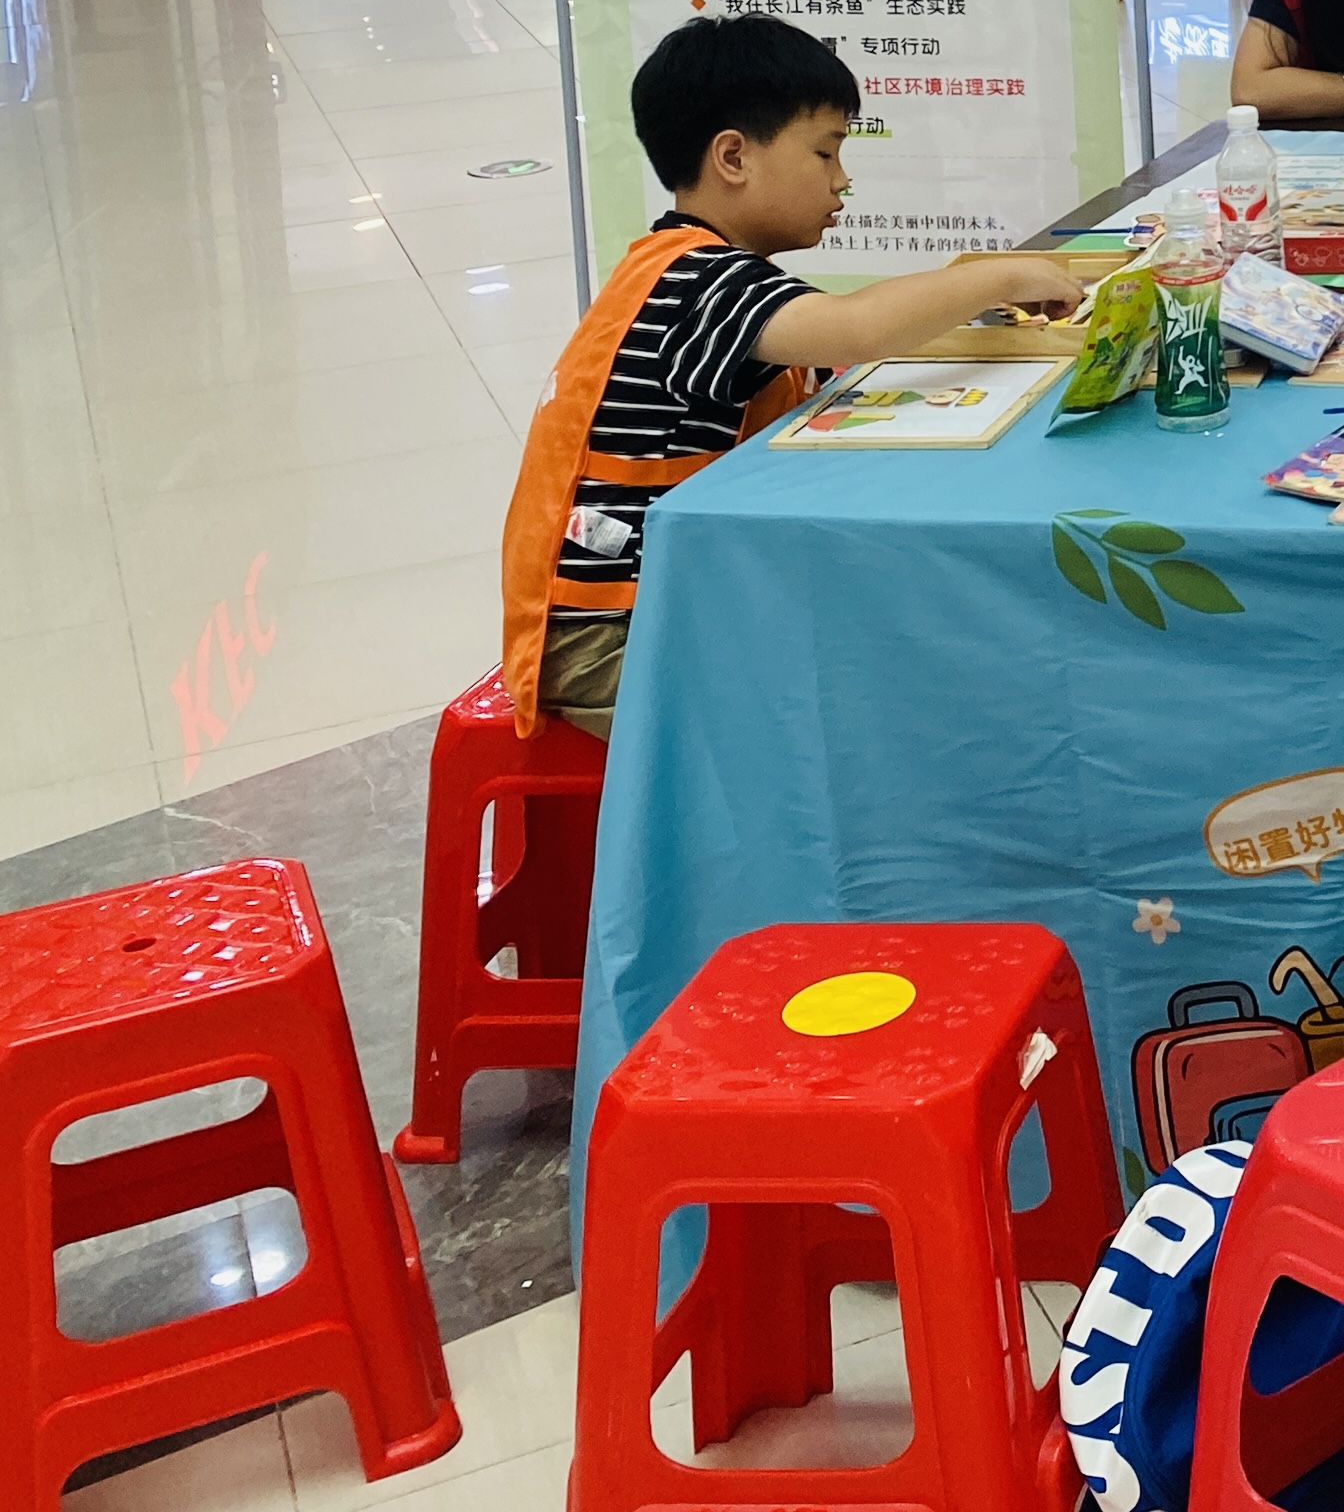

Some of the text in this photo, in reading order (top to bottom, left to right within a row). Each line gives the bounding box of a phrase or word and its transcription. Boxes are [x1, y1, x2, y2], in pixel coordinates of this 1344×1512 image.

[860, 37, 941, 56] 专项行动
[863, 76, 1026, 97] 社区环境治理实践
